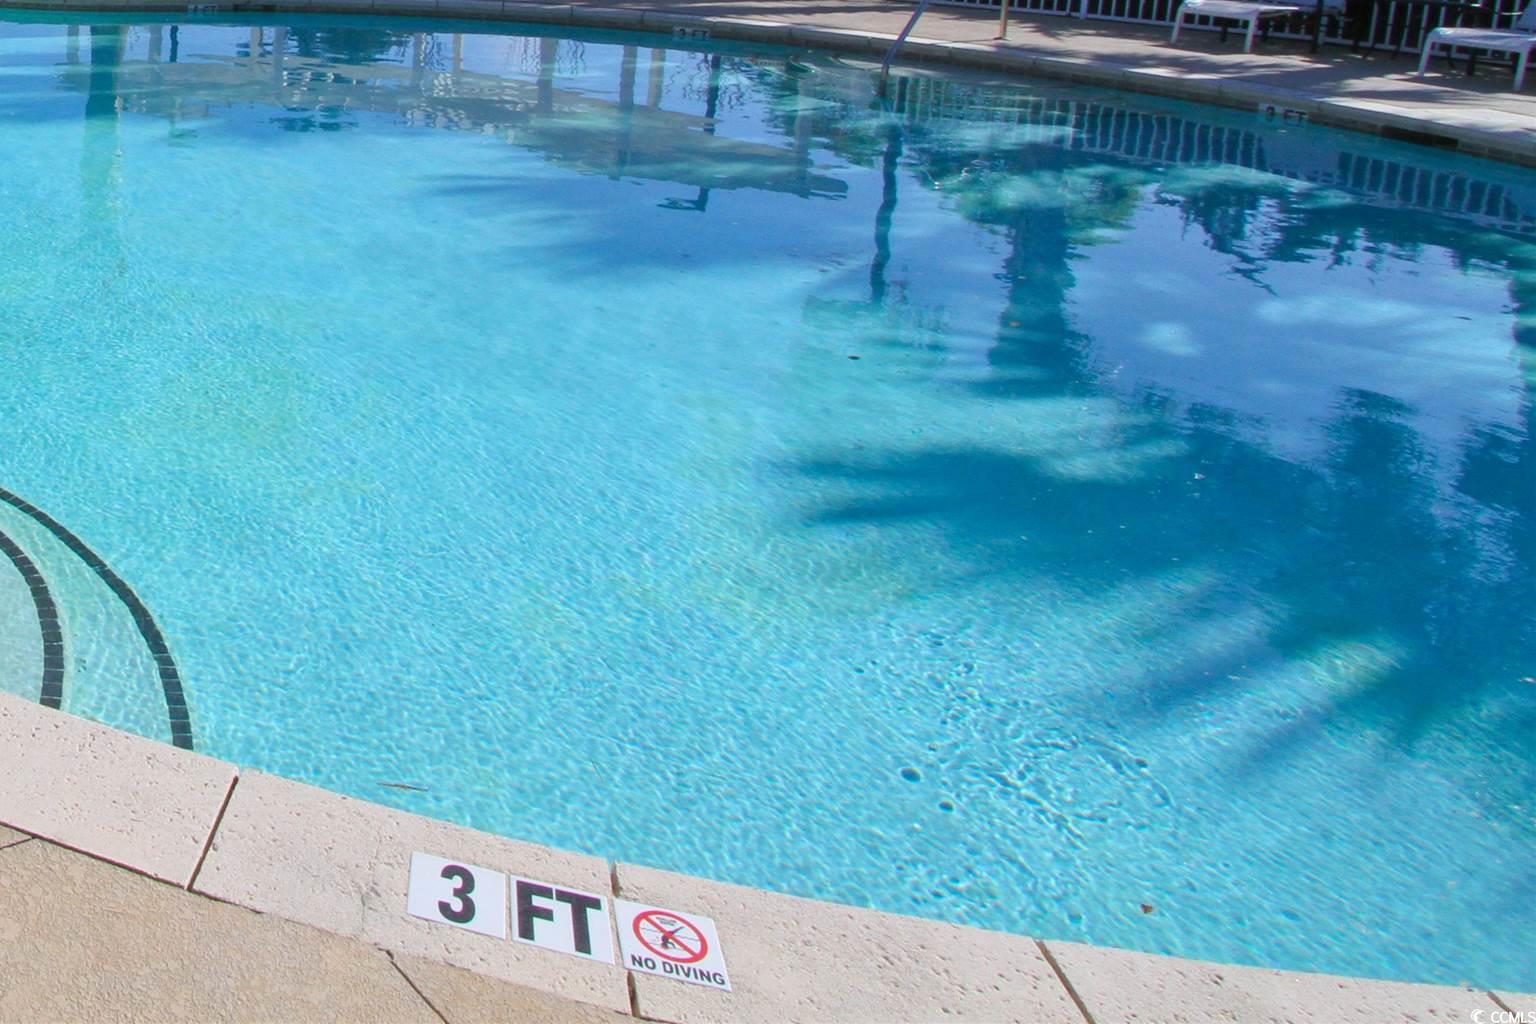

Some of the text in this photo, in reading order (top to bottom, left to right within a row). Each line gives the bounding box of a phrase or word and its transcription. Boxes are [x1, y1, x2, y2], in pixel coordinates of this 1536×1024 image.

[437, 864, 602, 956] 3 FT
[630, 953, 726, 986] NO DIVING
